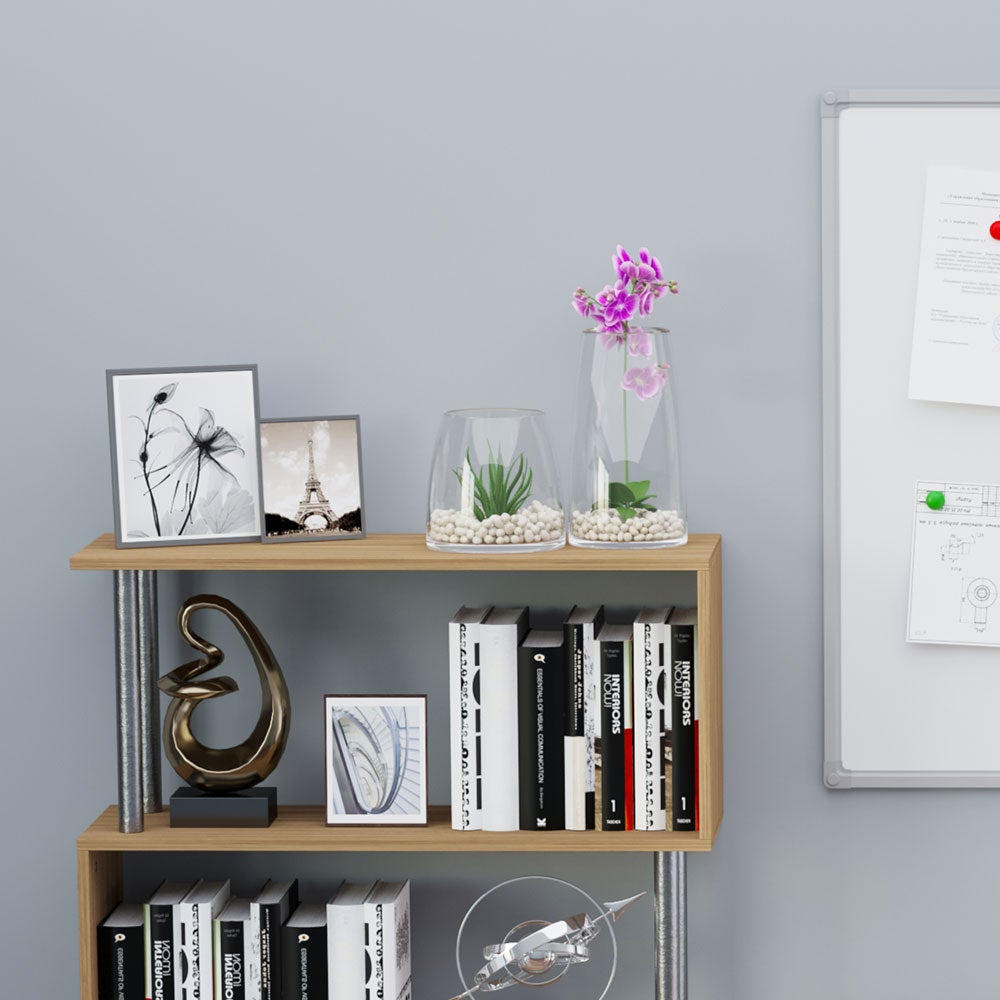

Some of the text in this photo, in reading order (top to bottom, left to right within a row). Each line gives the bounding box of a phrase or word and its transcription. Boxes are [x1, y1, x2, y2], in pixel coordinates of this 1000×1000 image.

[604, 674, 612, 707] NOW!
[674, 661, 682, 697] NOW!
[682, 661, 691, 726] INTERIORS
[537, 704, 544, 712] OF
[612, 674, 620, 734] INTERIORS
[611, 800, 616, 812] 1
[682, 797, 686, 810] 1
